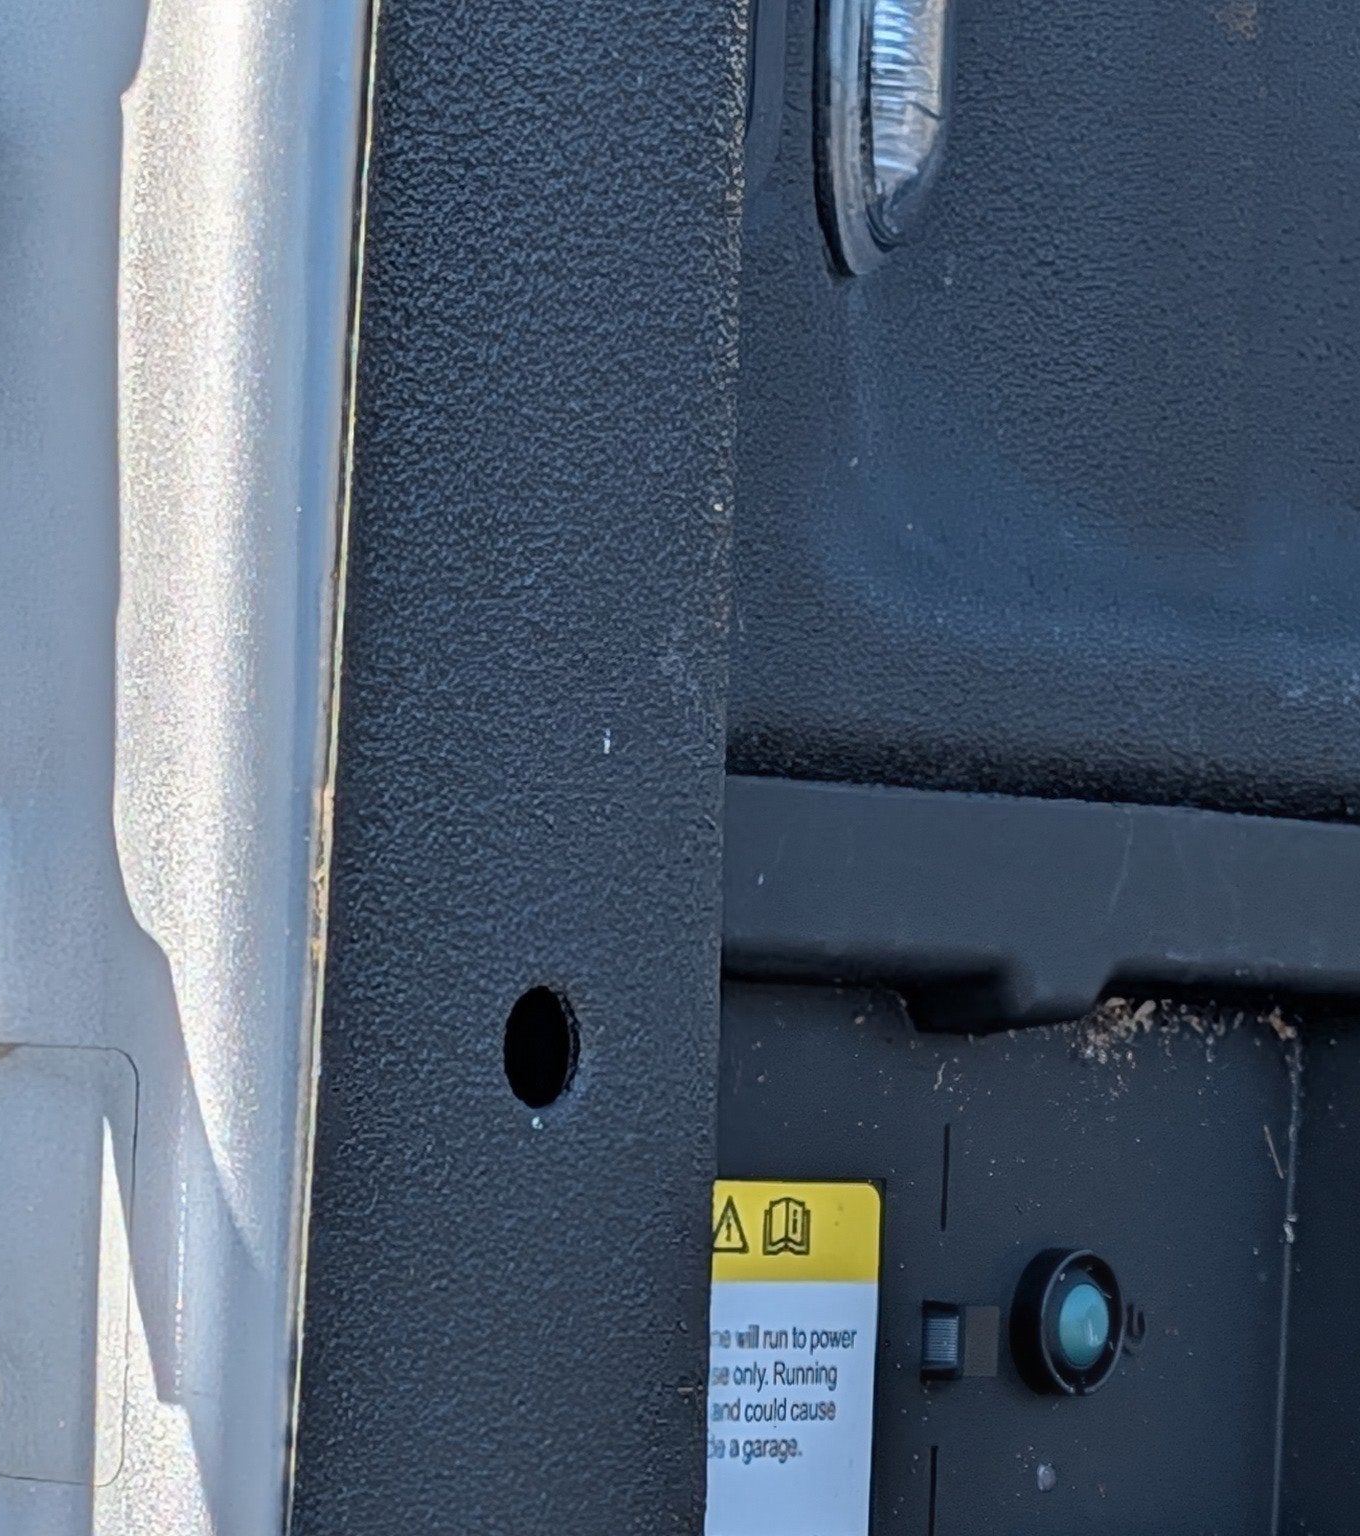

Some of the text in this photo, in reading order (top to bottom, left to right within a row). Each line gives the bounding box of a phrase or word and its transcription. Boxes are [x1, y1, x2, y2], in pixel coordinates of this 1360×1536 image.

[736, 1325, 759, 1349] will
[763, 1329, 788, 1349] run
[792, 1326, 807, 1349] to
[810, 1329, 857, 1355] power
[733, 1361, 768, 1393] only.
[772, 1360, 838, 1391] Running
[744, 1397, 787, 1422] could
[790, 1400, 837, 1422] cause
[729, 1438, 740, 1458] a
[742, 1437, 803, 1466] garage.
